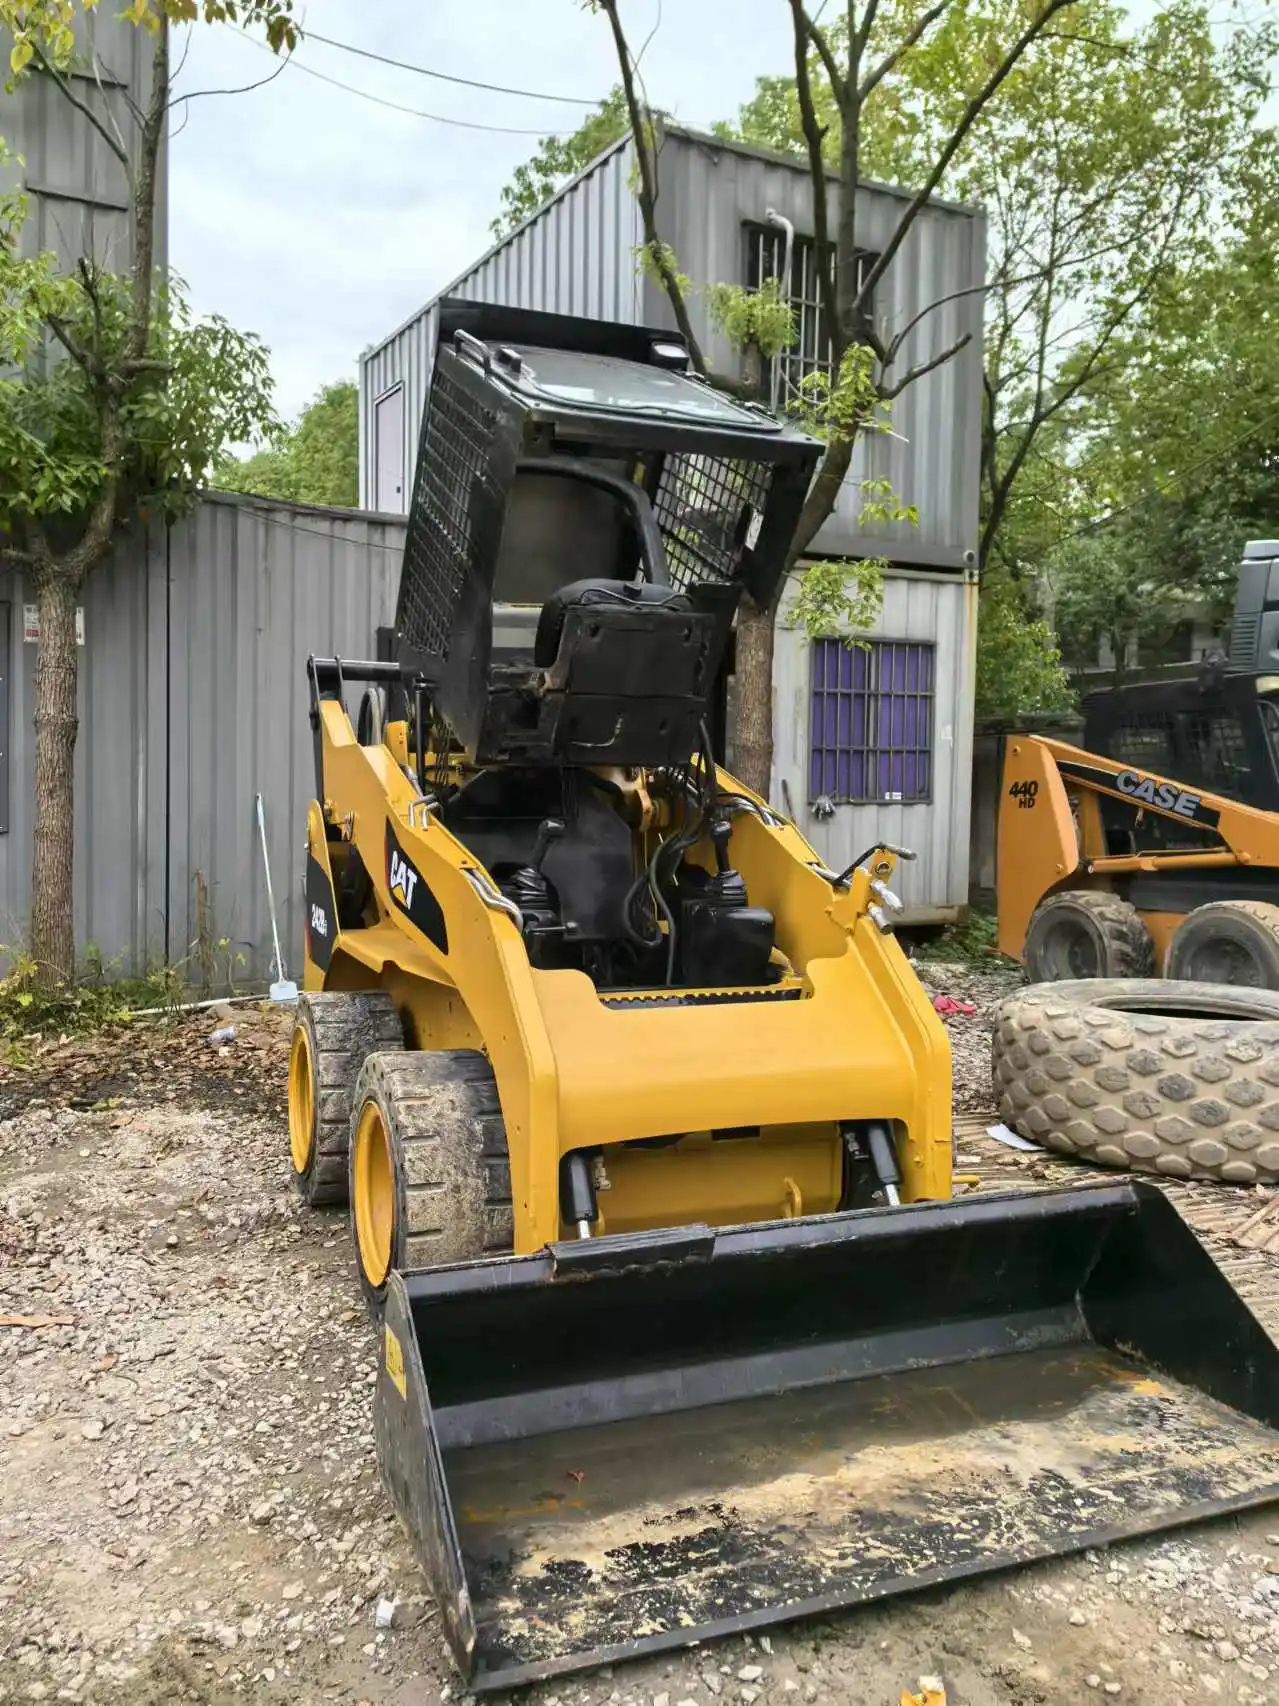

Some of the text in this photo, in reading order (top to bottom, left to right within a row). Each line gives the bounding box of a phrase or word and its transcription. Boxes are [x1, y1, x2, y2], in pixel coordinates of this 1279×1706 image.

[1009, 780, 1039, 798] 440
[1018, 798, 1036, 809] HD
[1116, 769, 1200, 817] CASE
[390, 850, 418, 910] CAT
